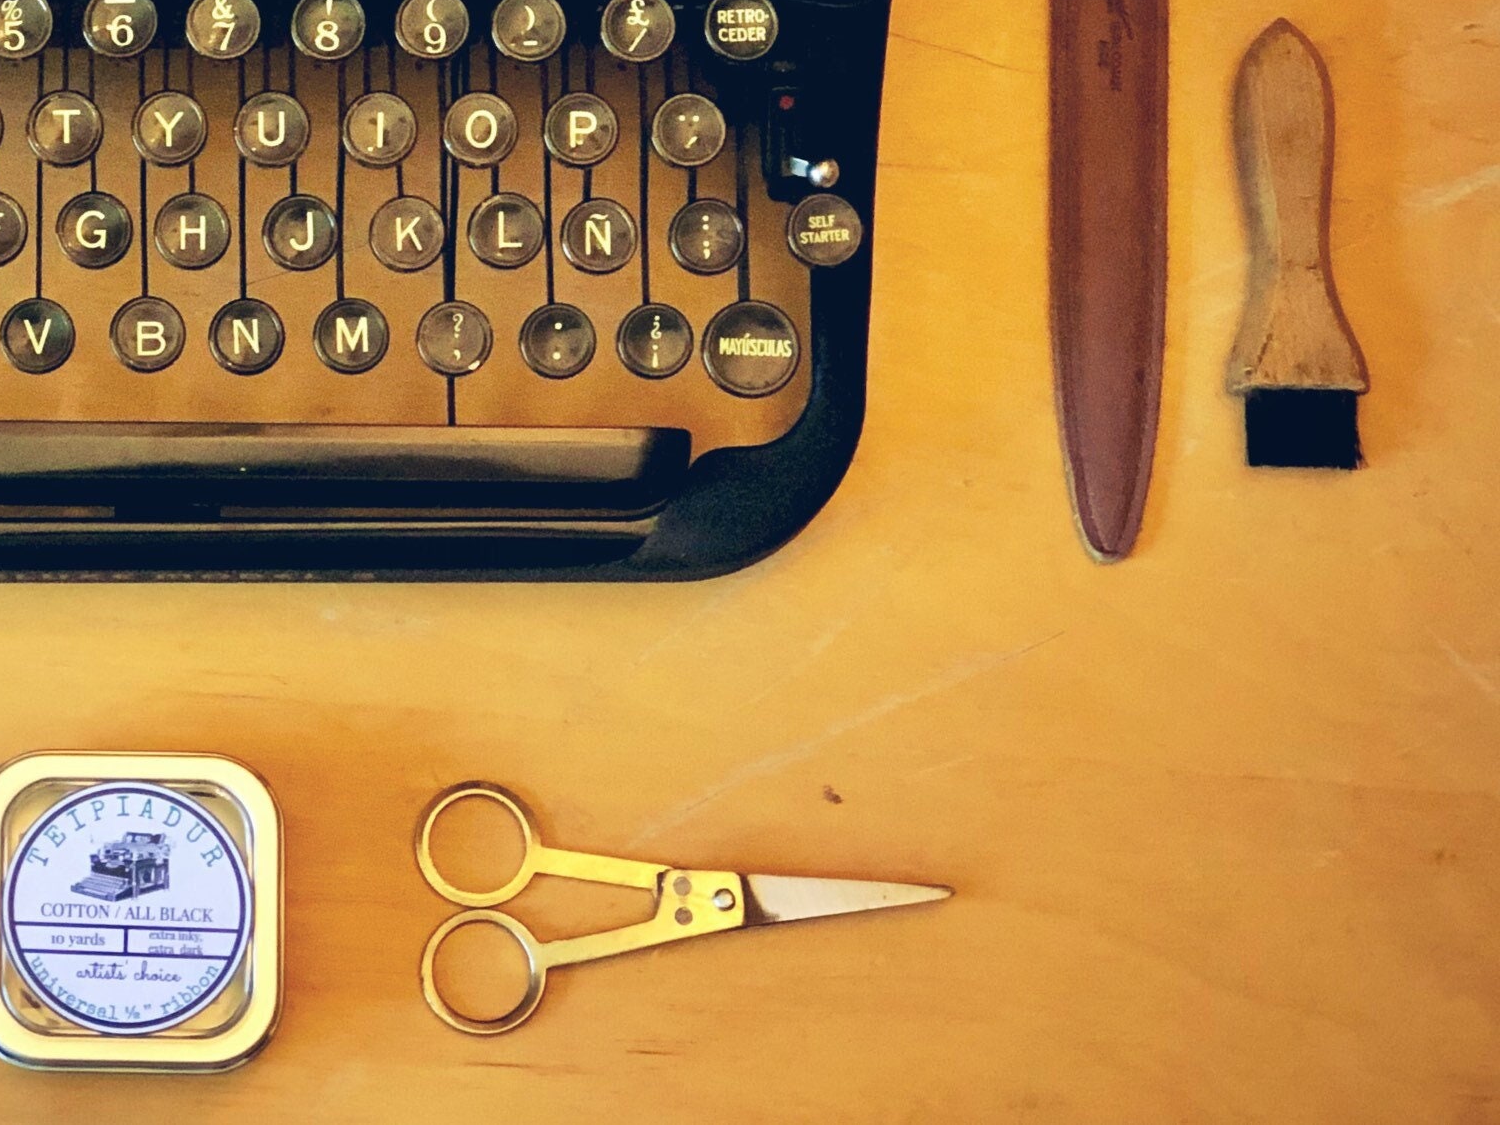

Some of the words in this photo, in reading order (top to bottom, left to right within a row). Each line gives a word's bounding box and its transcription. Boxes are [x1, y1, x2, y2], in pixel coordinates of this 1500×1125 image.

[110, 14, 134, 46] 6
[717, 9, 769, 24] RETRO-
[718, 27, 766, 42] CEDER
[3, 20, 25, 51] 5
[212, 22, 235, 51] 7
[314, 21, 340, 52] 8
[423, 22, 447, 54] 9
[52, 109, 81, 144] T
[154, 111, 184, 147] Y
[257, 111, 286, 147] U
[376, 111, 384, 148] I
[465, 110, 498, 148] O
[568, 110, 597, 148] P
[75, 210, 107, 249] G
[179, 215, 207, 251] H
[289, 211, 314, 251] J
[395, 216, 423, 252] K
[498, 211, 523, 248] L
[584, 213, 612, 256] Ñ
[799, 229, 850, 245] STARTER
[808, 214, 835, 229] SELF
[23, 318, 52, 355] V
[136, 321, 167, 357] B
[232, 318, 260, 355] N
[335, 317, 370, 354] M
[719, 332, 793, 358] MAYÚSCULAS
[27, 795, 224, 869] TEIPIADUR
[40, 902, 110, 920] COTTON
[124, 906, 156, 921] ALL
[159, 907, 214, 923] BLACK
[68, 931, 106, 950] yards
[148, 945, 174, 955] extra
[149, 930, 175, 941] extra
[30, 956, 120, 1021] universal
[160, 964, 220, 1017] ribbon
[133, 960, 182, 982] choice
